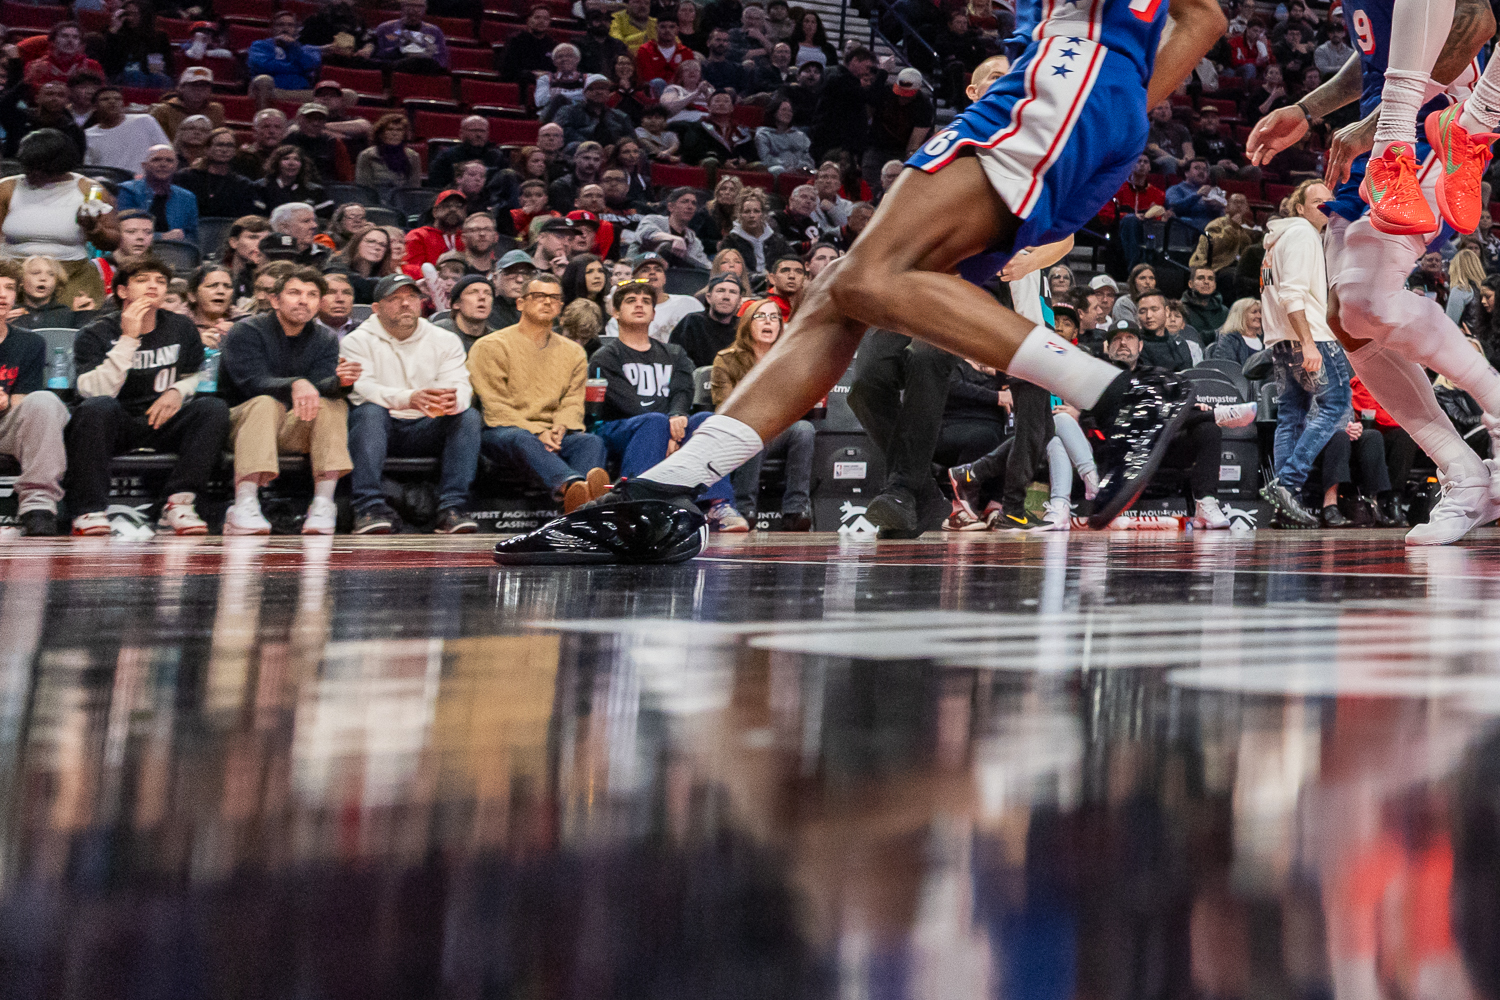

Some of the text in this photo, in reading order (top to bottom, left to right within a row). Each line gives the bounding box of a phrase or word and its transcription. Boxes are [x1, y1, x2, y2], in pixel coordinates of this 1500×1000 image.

[1352, 10, 1376, 55] 9
[1196, 394, 1237, 403] ketmaster
[469, 510, 501, 519] PIRIT
[1139, 509, 1188, 518] MOUNTAIN
